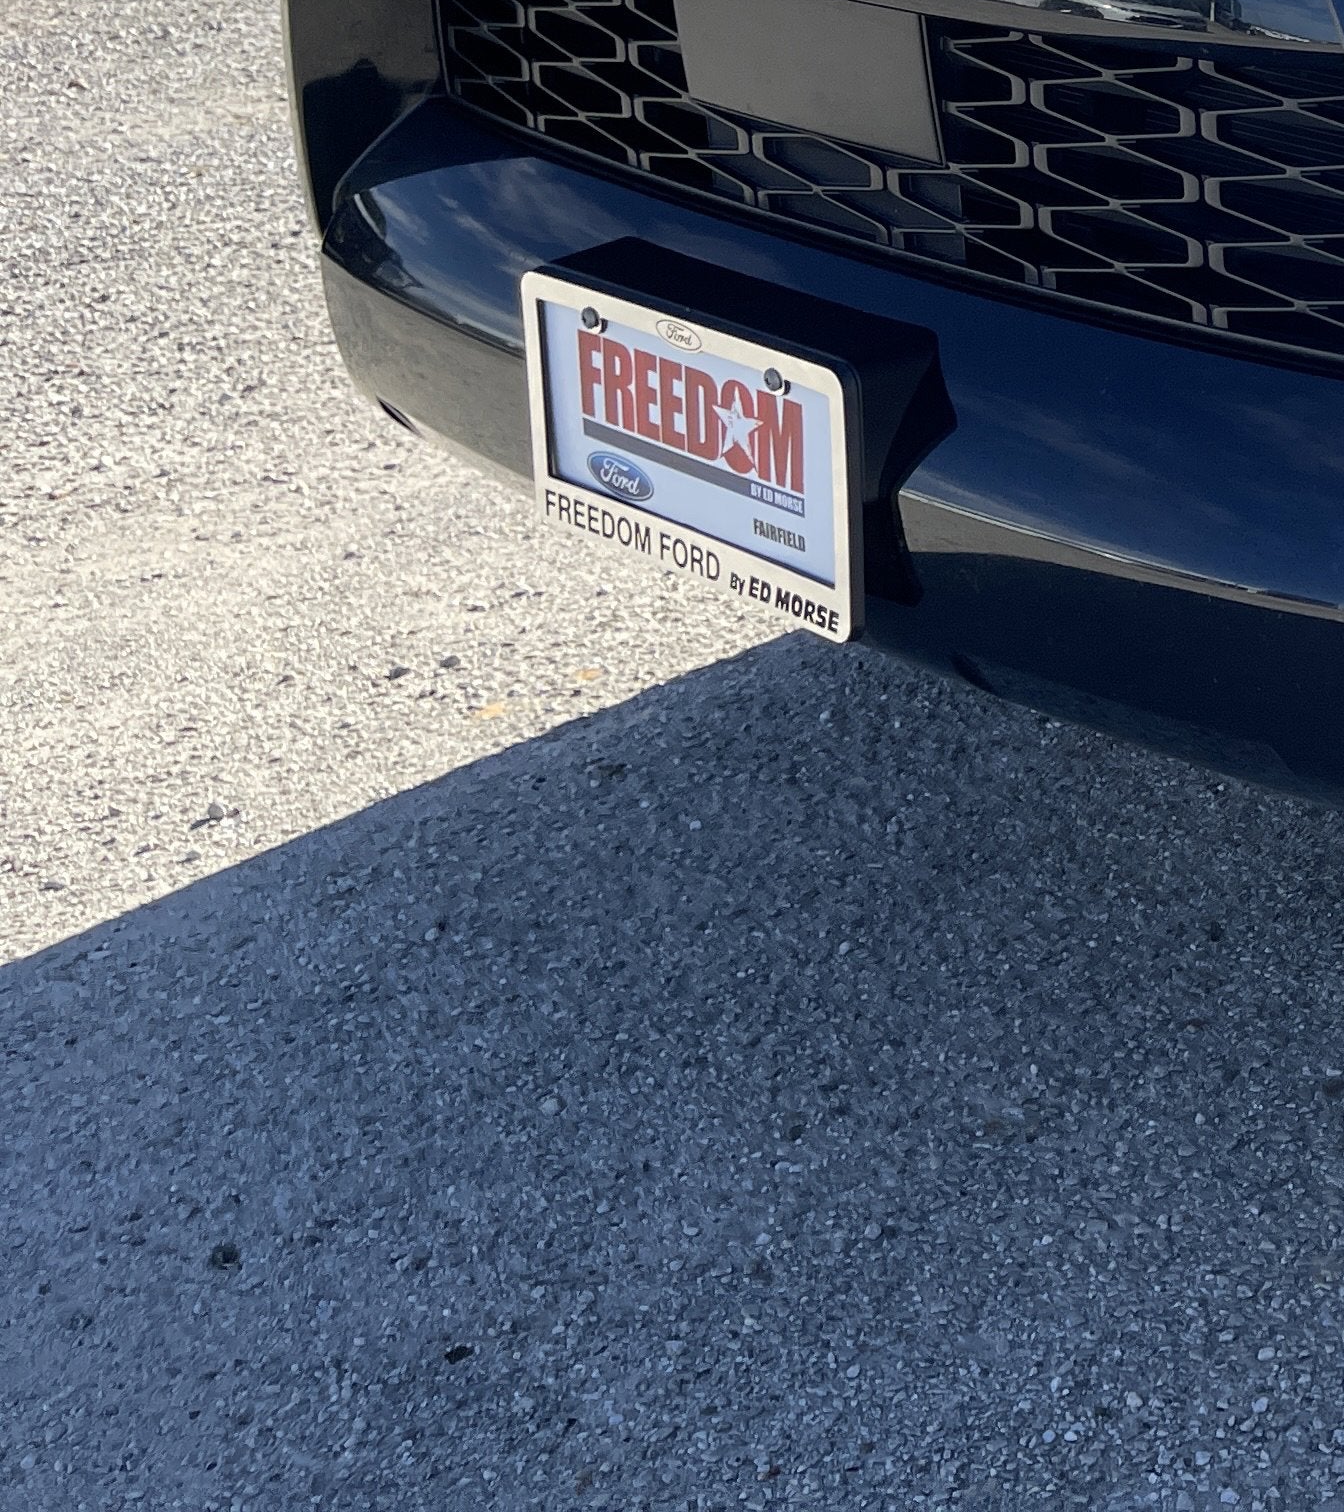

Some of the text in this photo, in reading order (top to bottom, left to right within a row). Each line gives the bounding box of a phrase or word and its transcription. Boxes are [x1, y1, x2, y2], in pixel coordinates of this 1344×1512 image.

[665, 322, 694, 346] Ford
[577, 329, 806, 495] FREEDOM
[599, 457, 641, 496] Ford
[773, 491, 805, 514] MORSE
[753, 518, 806, 552] FAIRFIELD
[545, 489, 651, 556] FREEDOM
[659, 531, 721, 581] FORD
[748, 575, 772, 603] ED
[774, 586, 840, 633] MORSE
